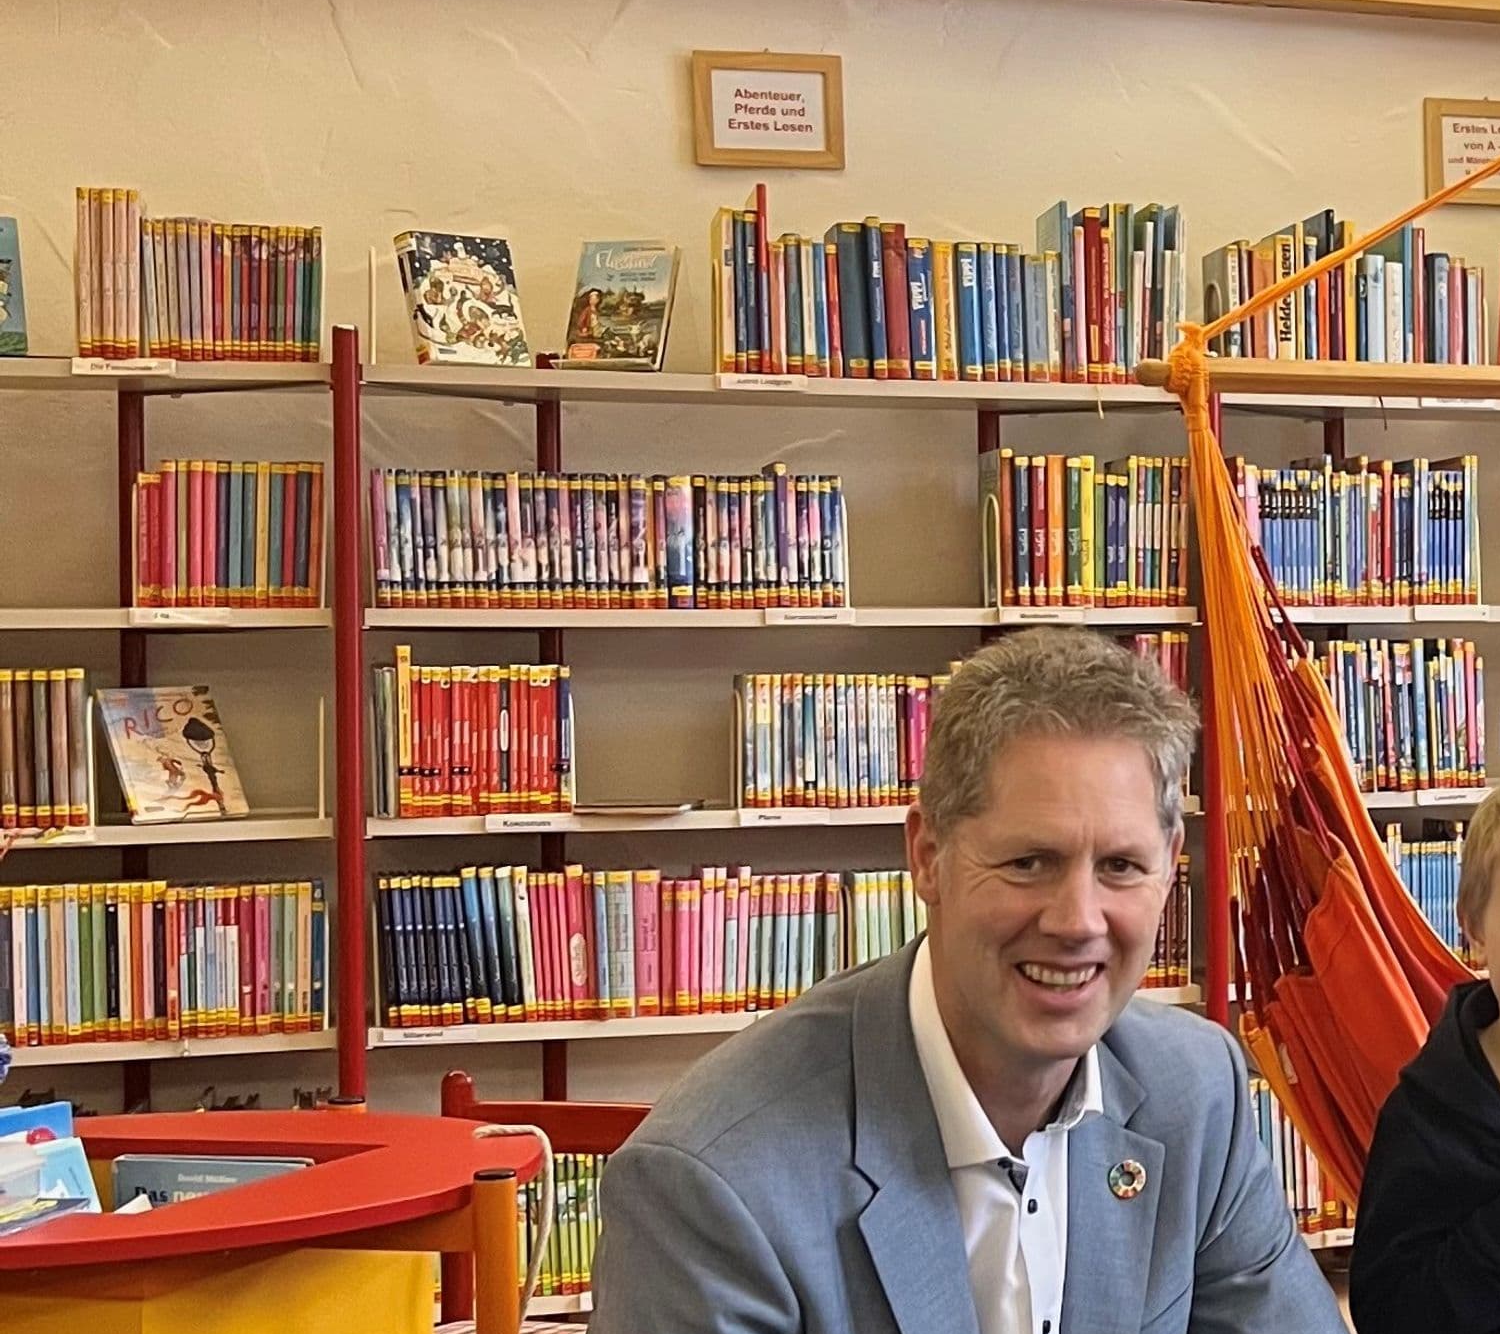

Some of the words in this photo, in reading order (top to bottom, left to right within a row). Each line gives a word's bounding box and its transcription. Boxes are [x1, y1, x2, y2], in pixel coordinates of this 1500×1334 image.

[734, 88, 805, 103] Abenteuer,
[734, 103, 776, 116] Pferde
[781, 107, 805, 117] und
[728, 118, 770, 131] Erstes
[774, 120, 813, 133] Lesen
[1453, 123, 1487, 134] Erstes
[1464, 143, 1483, 151] von
[1487, 141, 1496, 151] A
[124, 698, 194, 740] RICO
